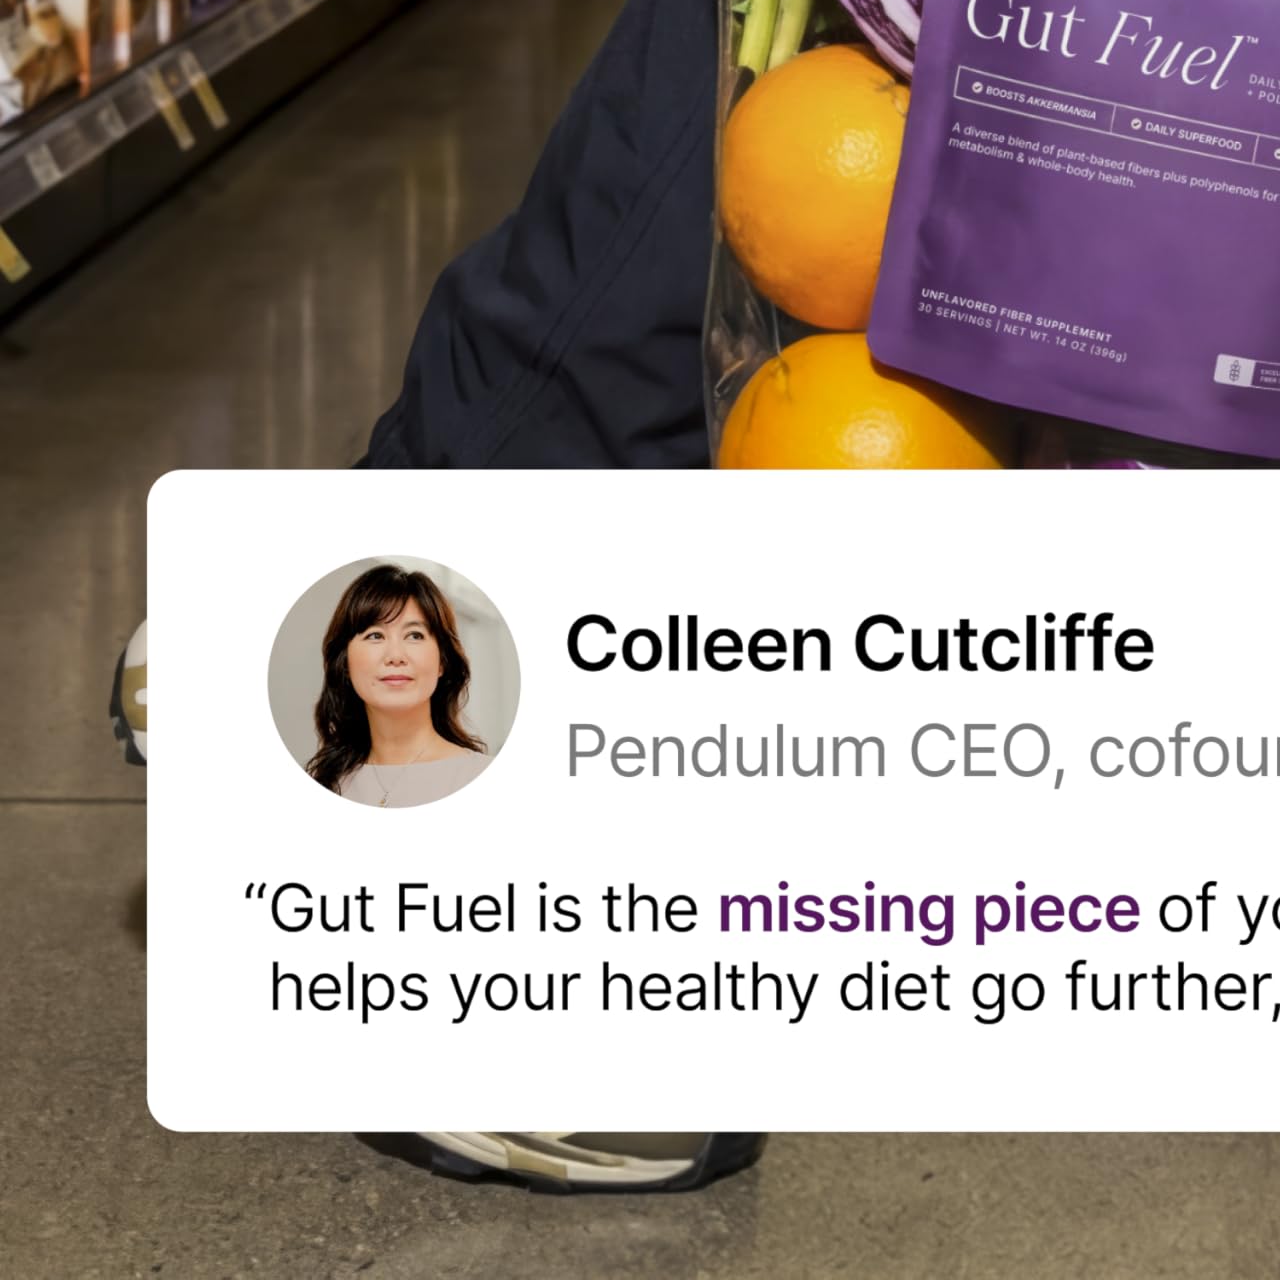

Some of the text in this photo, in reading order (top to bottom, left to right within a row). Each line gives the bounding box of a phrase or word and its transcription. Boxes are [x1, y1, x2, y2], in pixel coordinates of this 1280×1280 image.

[985, 85, 1097, 121] BOOSTS AKKERMANSIA
[948, 137, 1136, 188] metabolism & whole-body health.
[951, 121, 961, 134] A
[963, 125, 1006, 147] diverse
[1007, 135, 1041, 152] blend
[1041, 144, 1056, 156] of
[1056, 147, 1126, 171] plant-based
[1127, 161, 1161, 179] fibers
[1162, 170, 1188, 184] plus
[1189, 176, 1260, 199] polyphenols
[1262, 189, 1280, 202] for
[1144, 121, 1243, 151] DAILY SUPERFOOD
[917, 301, 933, 314] 30
[935, 306, 992, 329] SERVINGS
[1002, 323, 1027, 337] NET
[1030, 329, 1050, 343] WT.
[1055, 335, 1067, 347] 14
[1070, 340, 1087, 353] OZ
[1090, 344, 1127, 363] (396g)
[921, 287, 1113, 343] UNFLAVORED FIBER SUPPLEMENT
